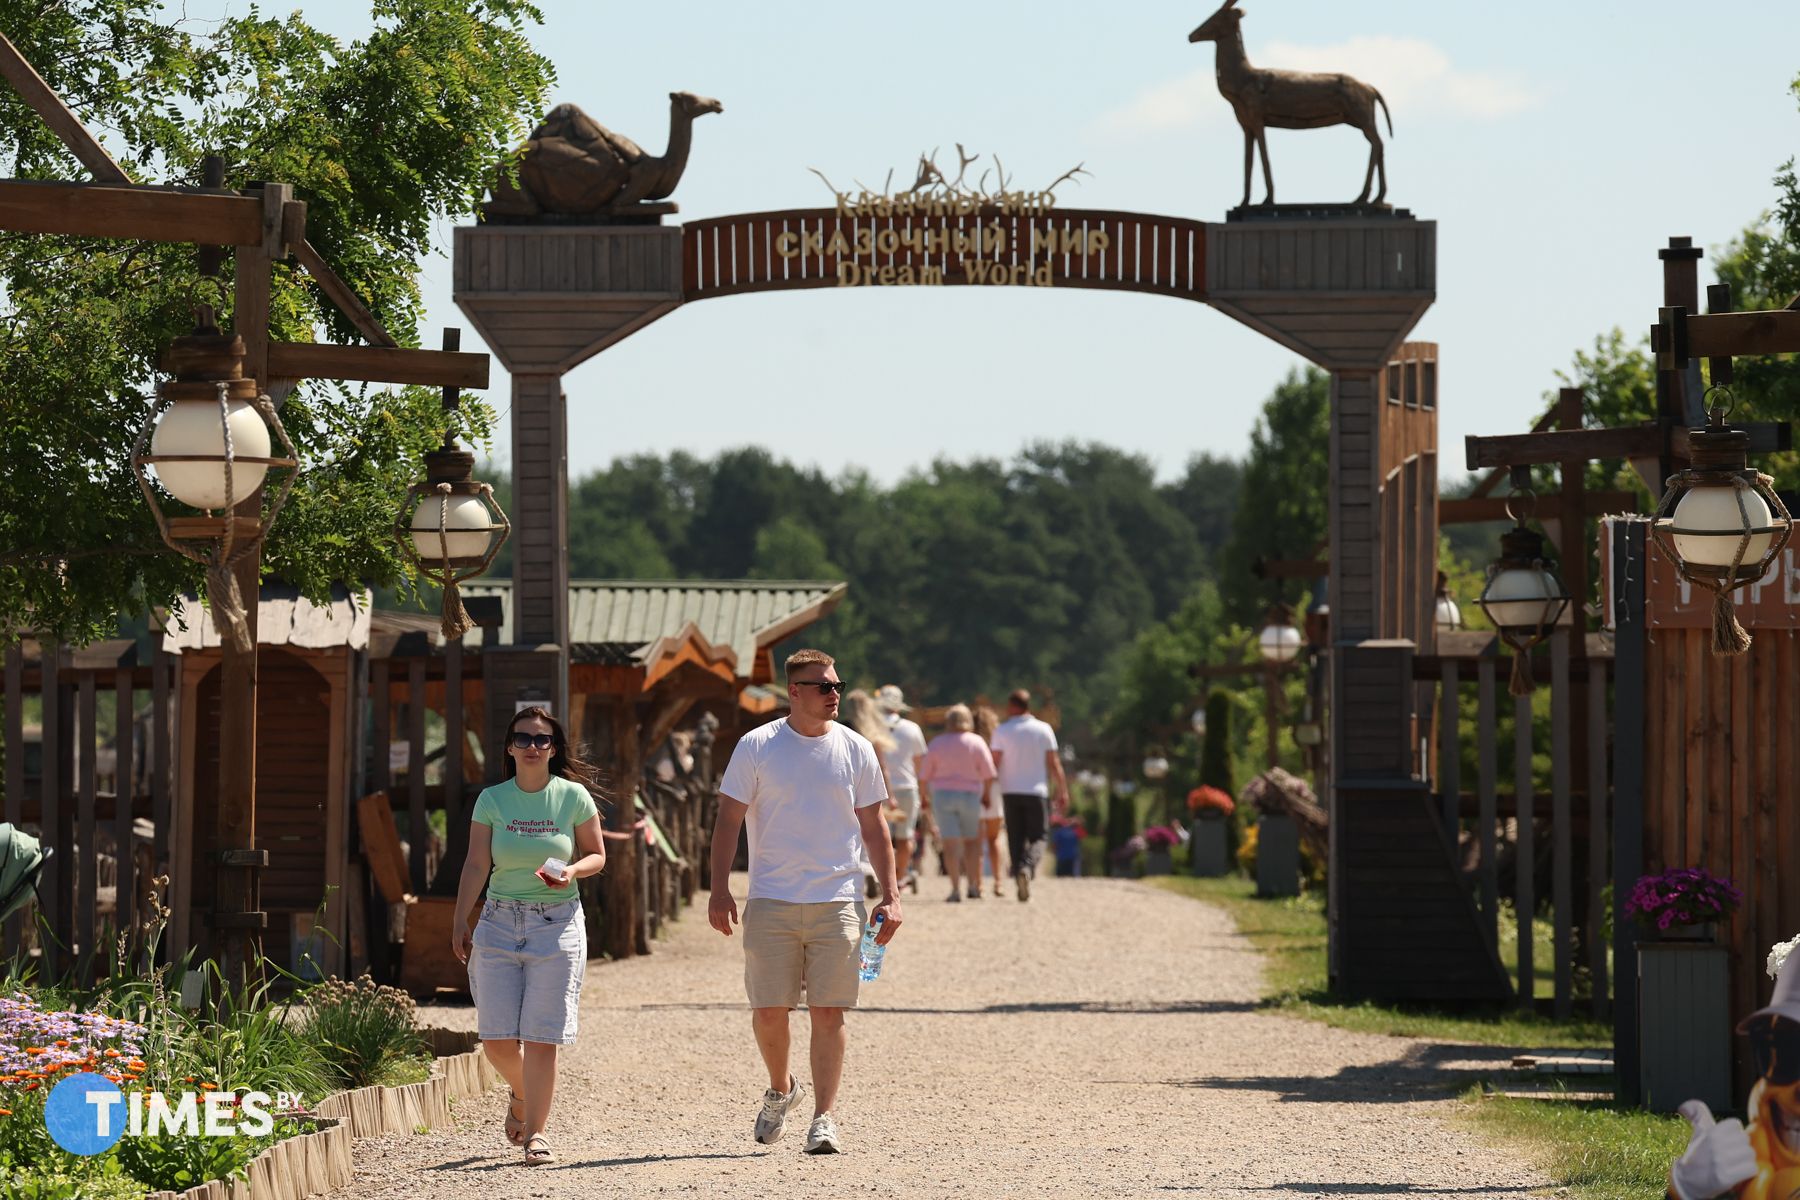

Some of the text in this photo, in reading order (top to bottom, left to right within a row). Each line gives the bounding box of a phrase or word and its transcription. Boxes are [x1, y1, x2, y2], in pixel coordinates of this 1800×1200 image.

[775, 221, 1110, 258] СКАЗОЧНЫЙ МИР
[837, 258, 1054, 287] Dream World
